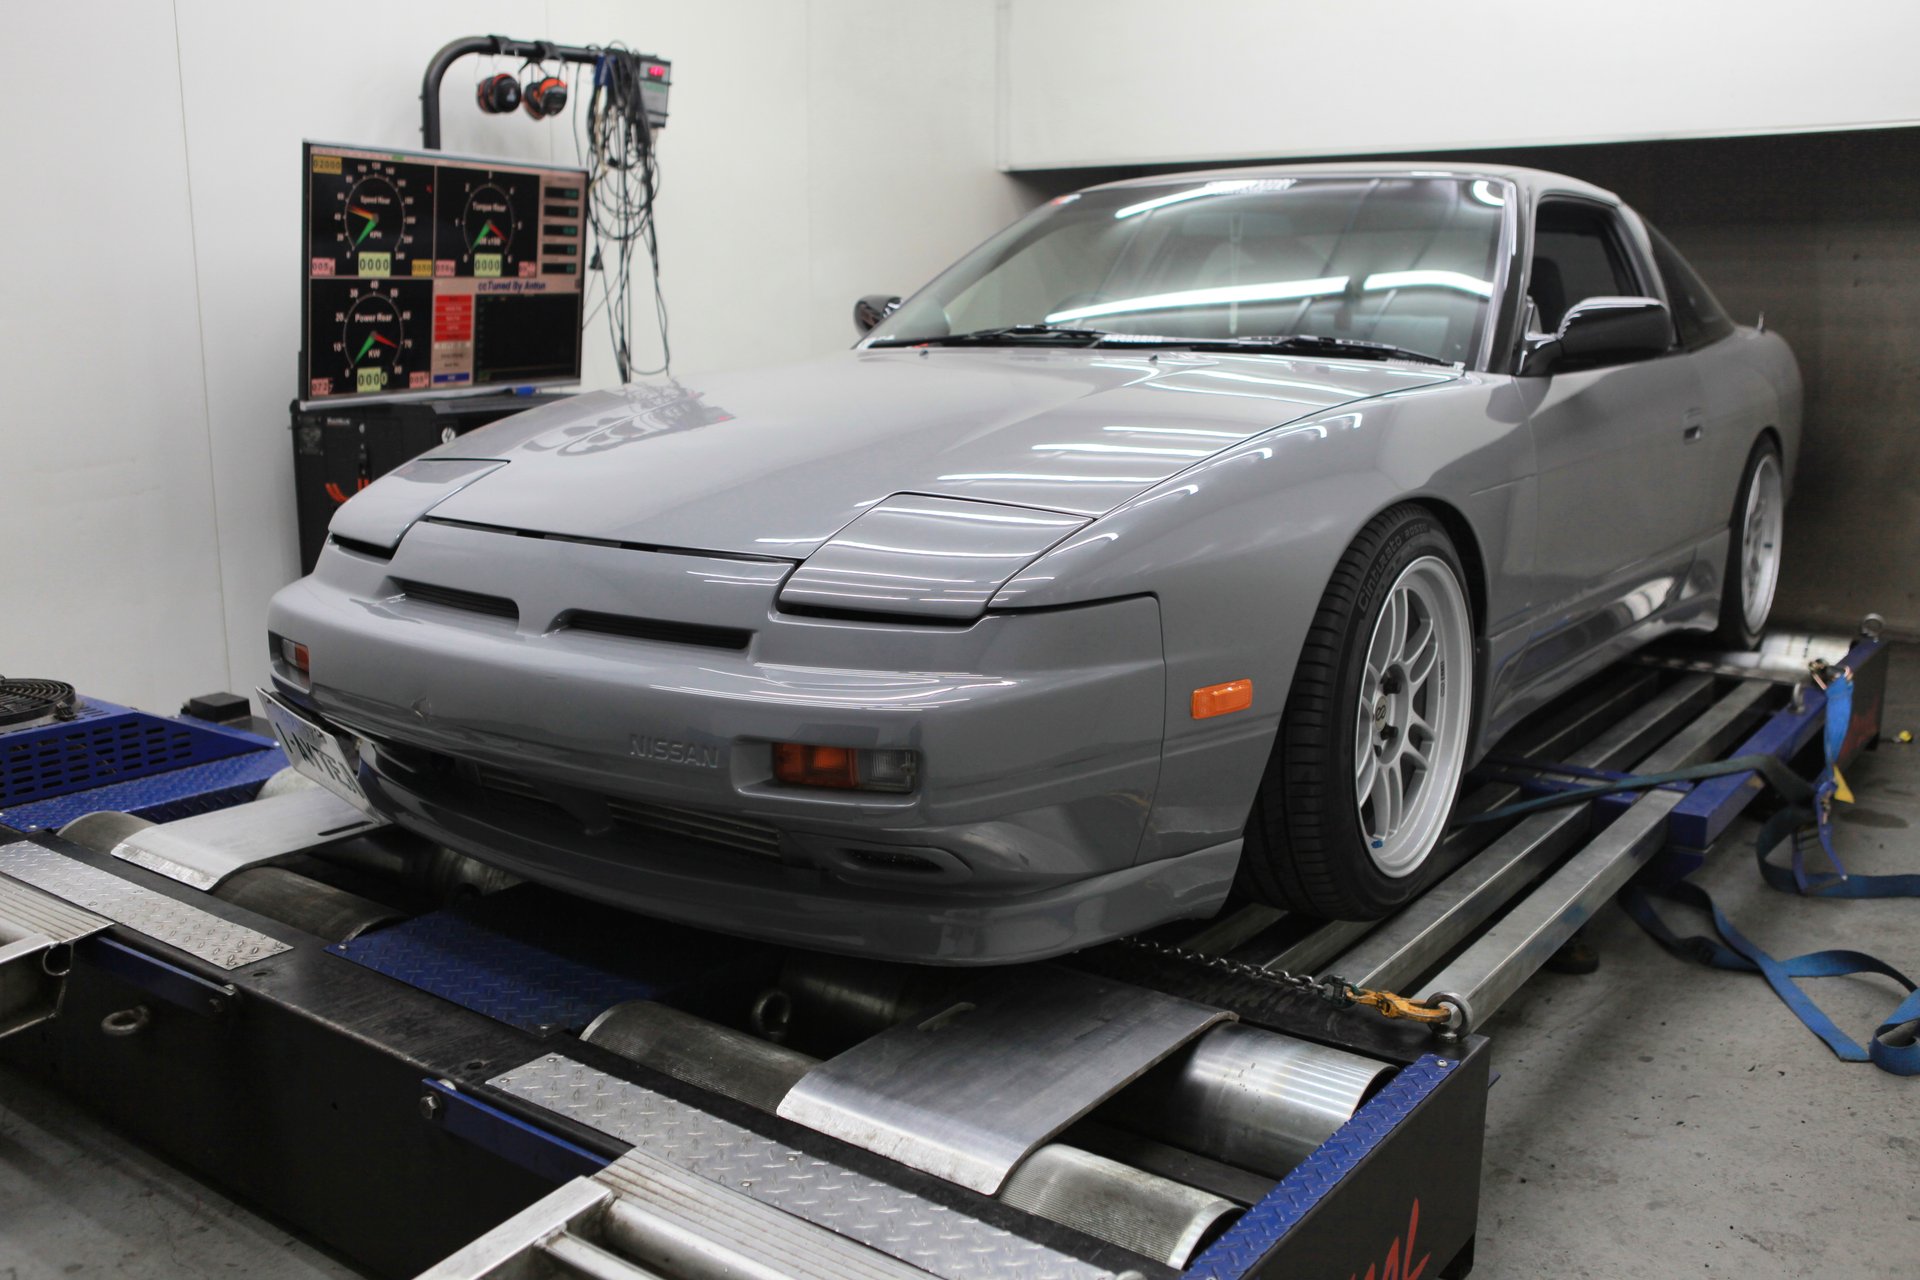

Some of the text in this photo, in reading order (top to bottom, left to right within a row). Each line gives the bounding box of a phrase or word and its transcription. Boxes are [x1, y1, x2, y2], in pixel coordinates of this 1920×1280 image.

[359, 258, 390, 271] 0000
[474, 259, 500, 271] 0000
[335, 312, 344, 322] 20
[355, 313, 392, 322] Power Rear
[333, 343, 341, 352] 10
[368, 349, 380, 358] KW
[629, 733, 719, 768] NISSAN
